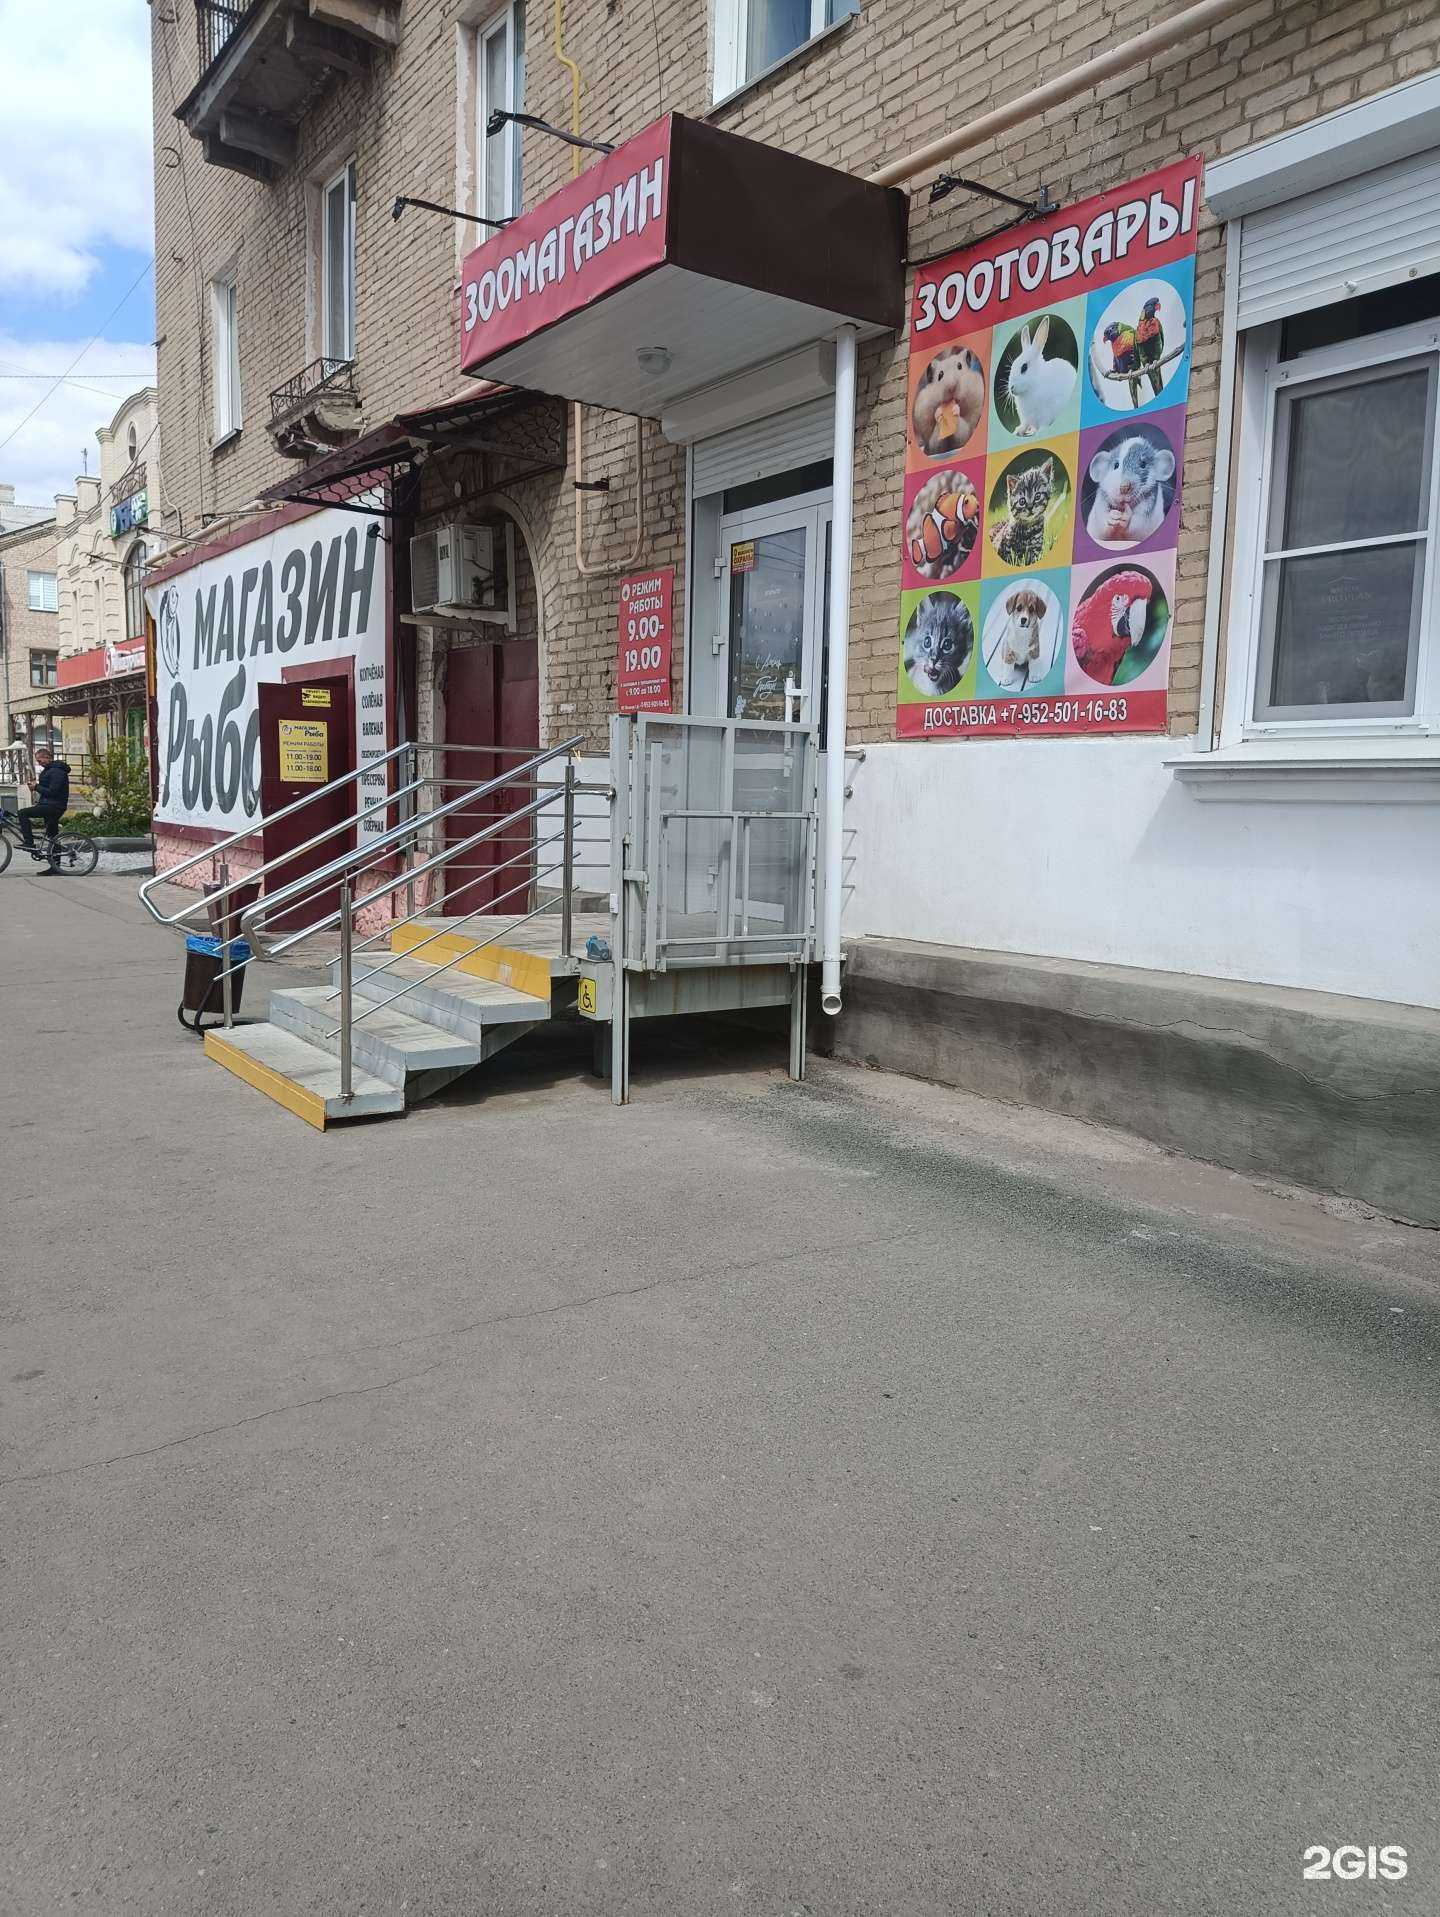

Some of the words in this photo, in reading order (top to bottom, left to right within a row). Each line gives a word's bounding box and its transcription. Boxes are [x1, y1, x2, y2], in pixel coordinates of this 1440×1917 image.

[464, 157, 664, 333] ЗООМАГАЗИН
[915, 176, 1198, 332] ЗООТОВАРЫ
[193, 524, 377, 670] МАГАЗИН
[632, 578, 662, 597] РЕЖИМ
[629, 595, 663, 615] РАБОТЫ
[624, 645, 662, 673] 19.00
[923, 704, 997, 730] ДОСТАВКА
[1000, 698, 1128, 724] +7-952-501-16-83
